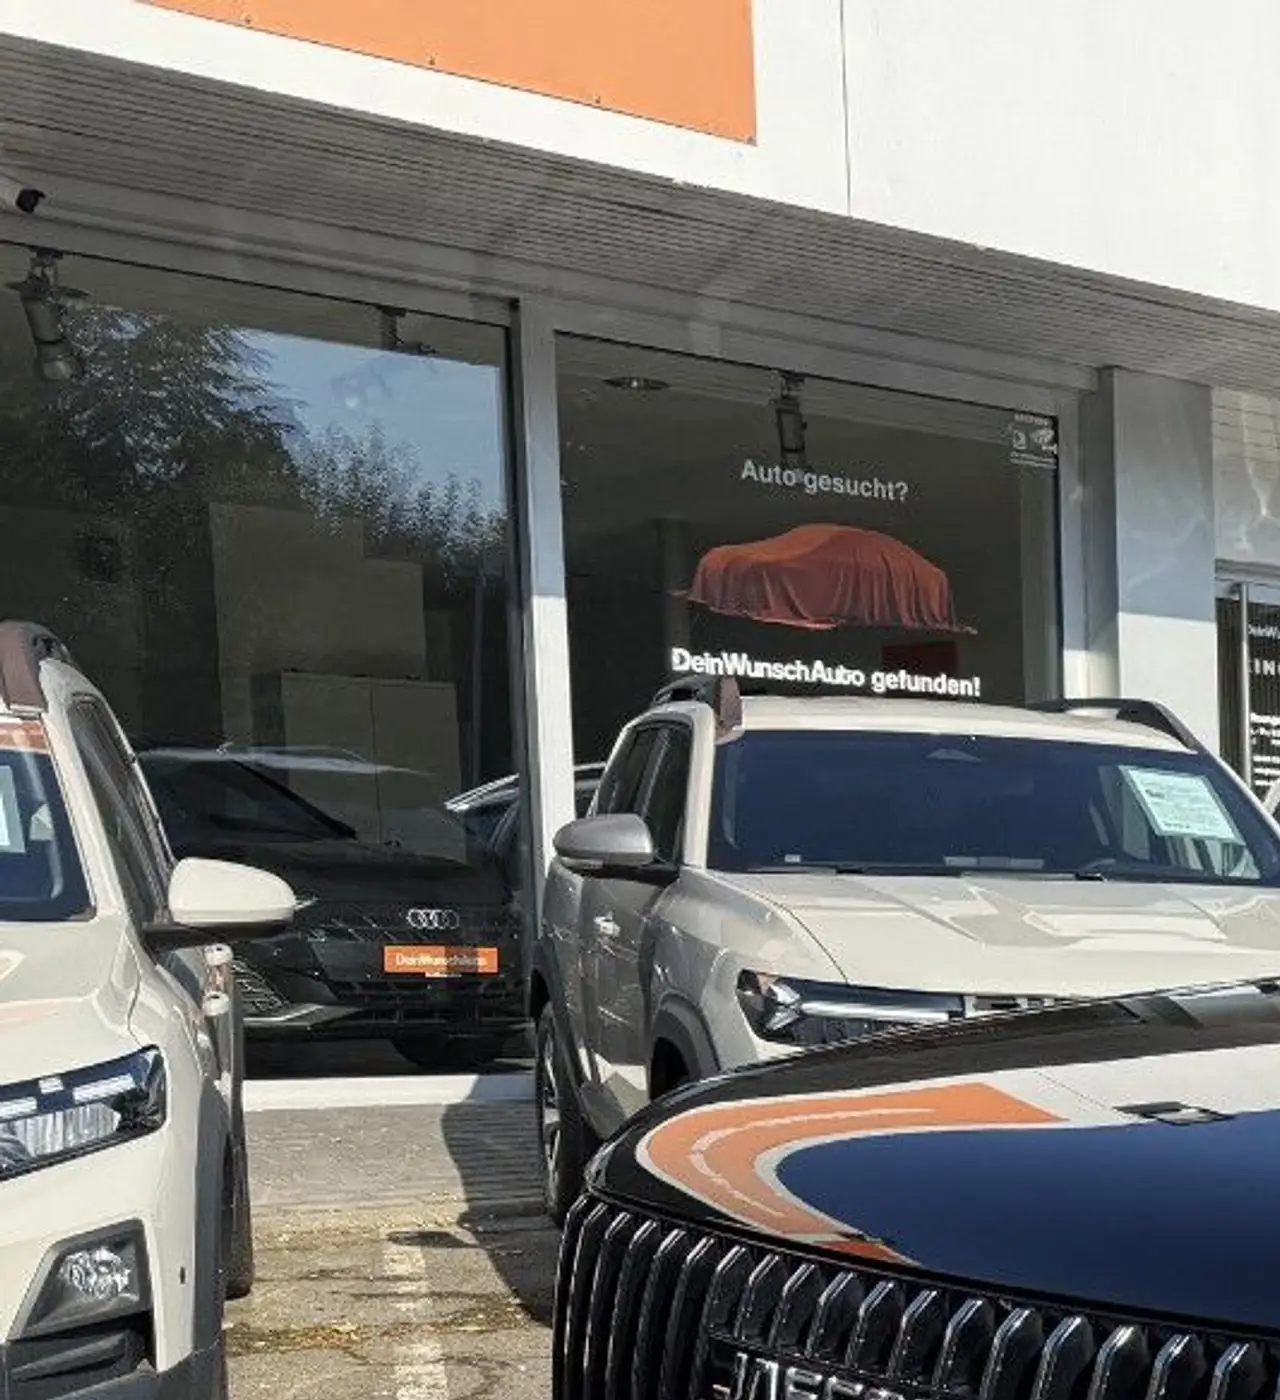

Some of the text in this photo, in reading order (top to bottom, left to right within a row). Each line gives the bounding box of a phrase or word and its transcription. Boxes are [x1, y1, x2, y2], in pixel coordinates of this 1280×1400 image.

[741, 459, 909, 502] Auto gesucht?
[671, 647, 982, 697] DeinWunschAuto gefunden!
